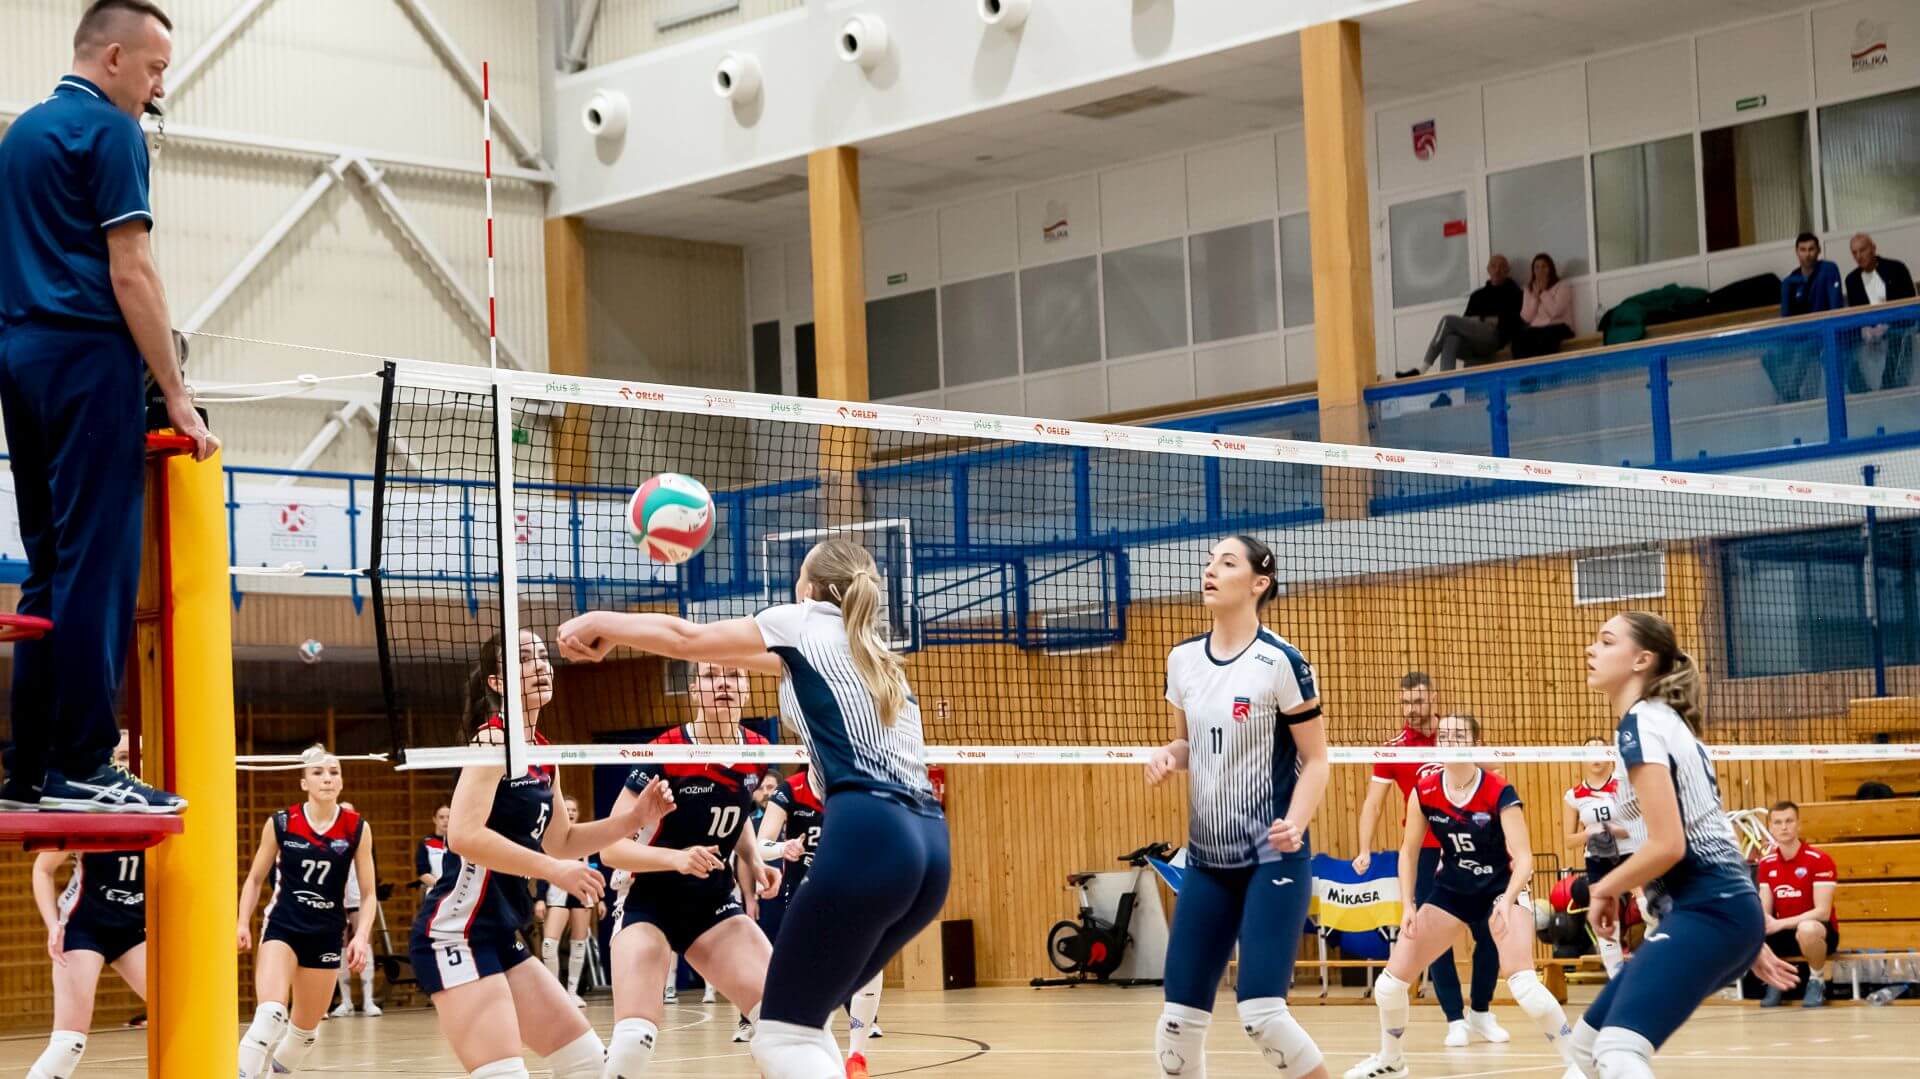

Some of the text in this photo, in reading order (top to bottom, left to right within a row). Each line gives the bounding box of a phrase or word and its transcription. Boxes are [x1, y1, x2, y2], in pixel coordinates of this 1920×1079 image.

[546, 381, 567, 393] plus
[635, 391, 664, 401] ORLEN
[771, 402, 790, 412] plus
[851, 410, 878, 419] ORLEN
[974, 419, 991, 429] plus
[1046, 427, 1070, 435] ORLEN
[1157, 436, 1173, 445] plus
[1224, 442, 1246, 450] ORLEN
[1385, 455, 1405, 463] ORLEN
[1533, 467, 1551, 475] ORLEN
[1210, 727, 1222, 754] 11
[561, 750, 577, 759] plus
[741, 750, 757, 758] plus
[1593, 807, 1610, 822] 19
[531, 803, 549, 839] 5
[707, 806, 741, 838] 10
[1448, 833, 1476, 853] 15
[118, 855, 139, 881] 11
[301, 860, 331, 884] 77
[106, 889, 144, 905] Eea
[445, 945, 462, 966] 5
